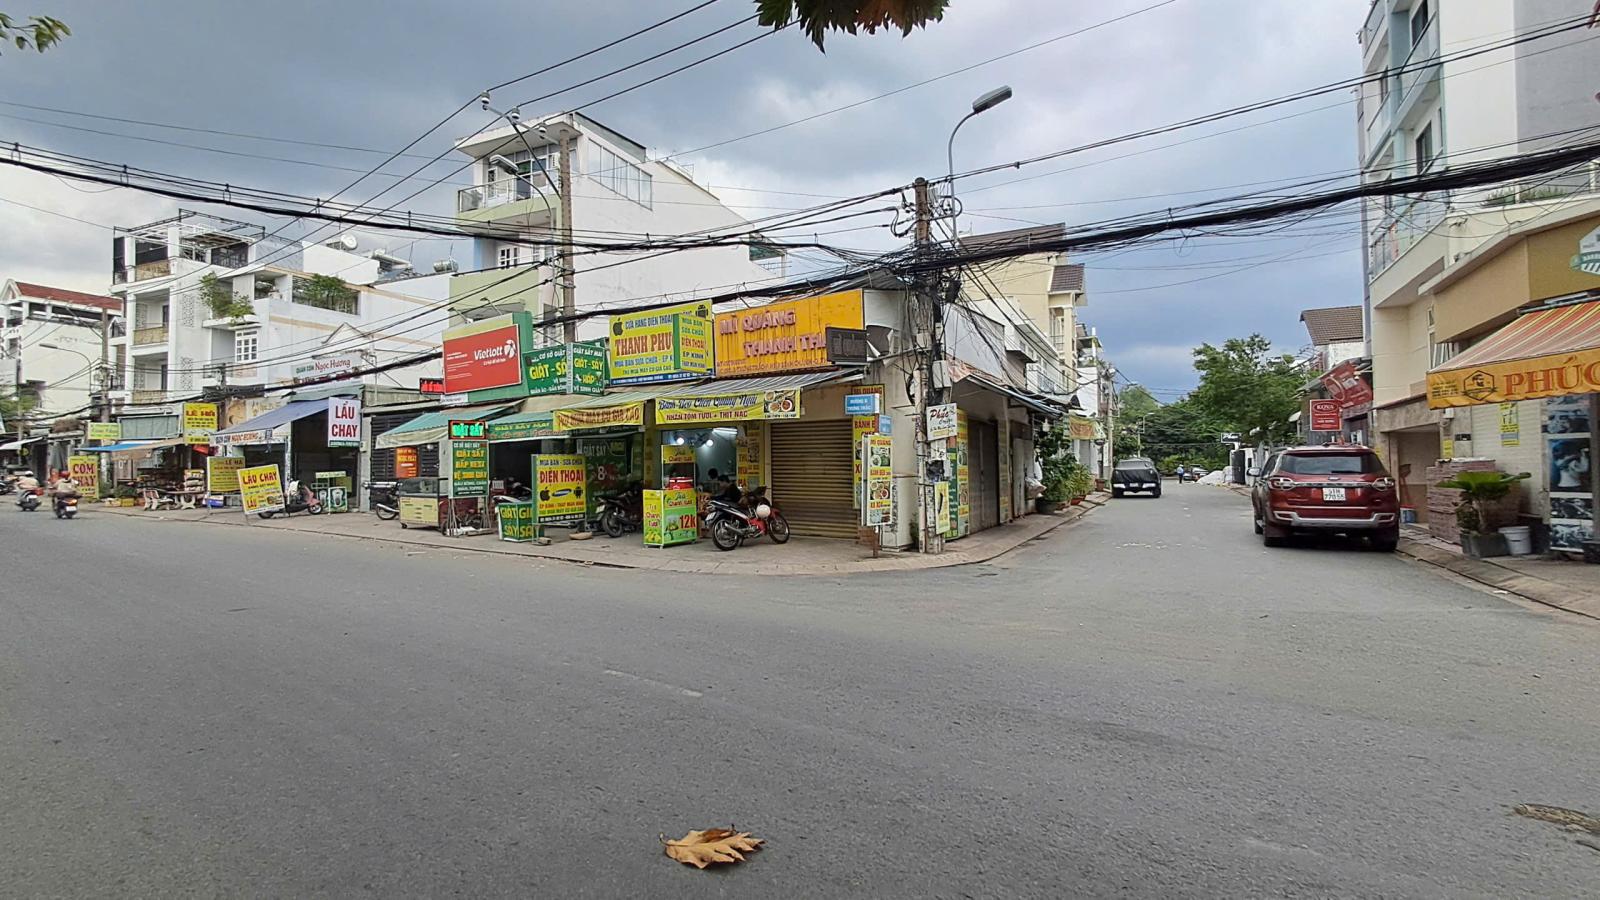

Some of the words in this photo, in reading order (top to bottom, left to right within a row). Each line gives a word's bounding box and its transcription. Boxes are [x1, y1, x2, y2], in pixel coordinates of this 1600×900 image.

[474, 346, 502, 360] Vietlott
[615, 335, 648, 356] THANH
[744, 336, 797, 358] THANH
[331, 424, 358, 438] CHAY
